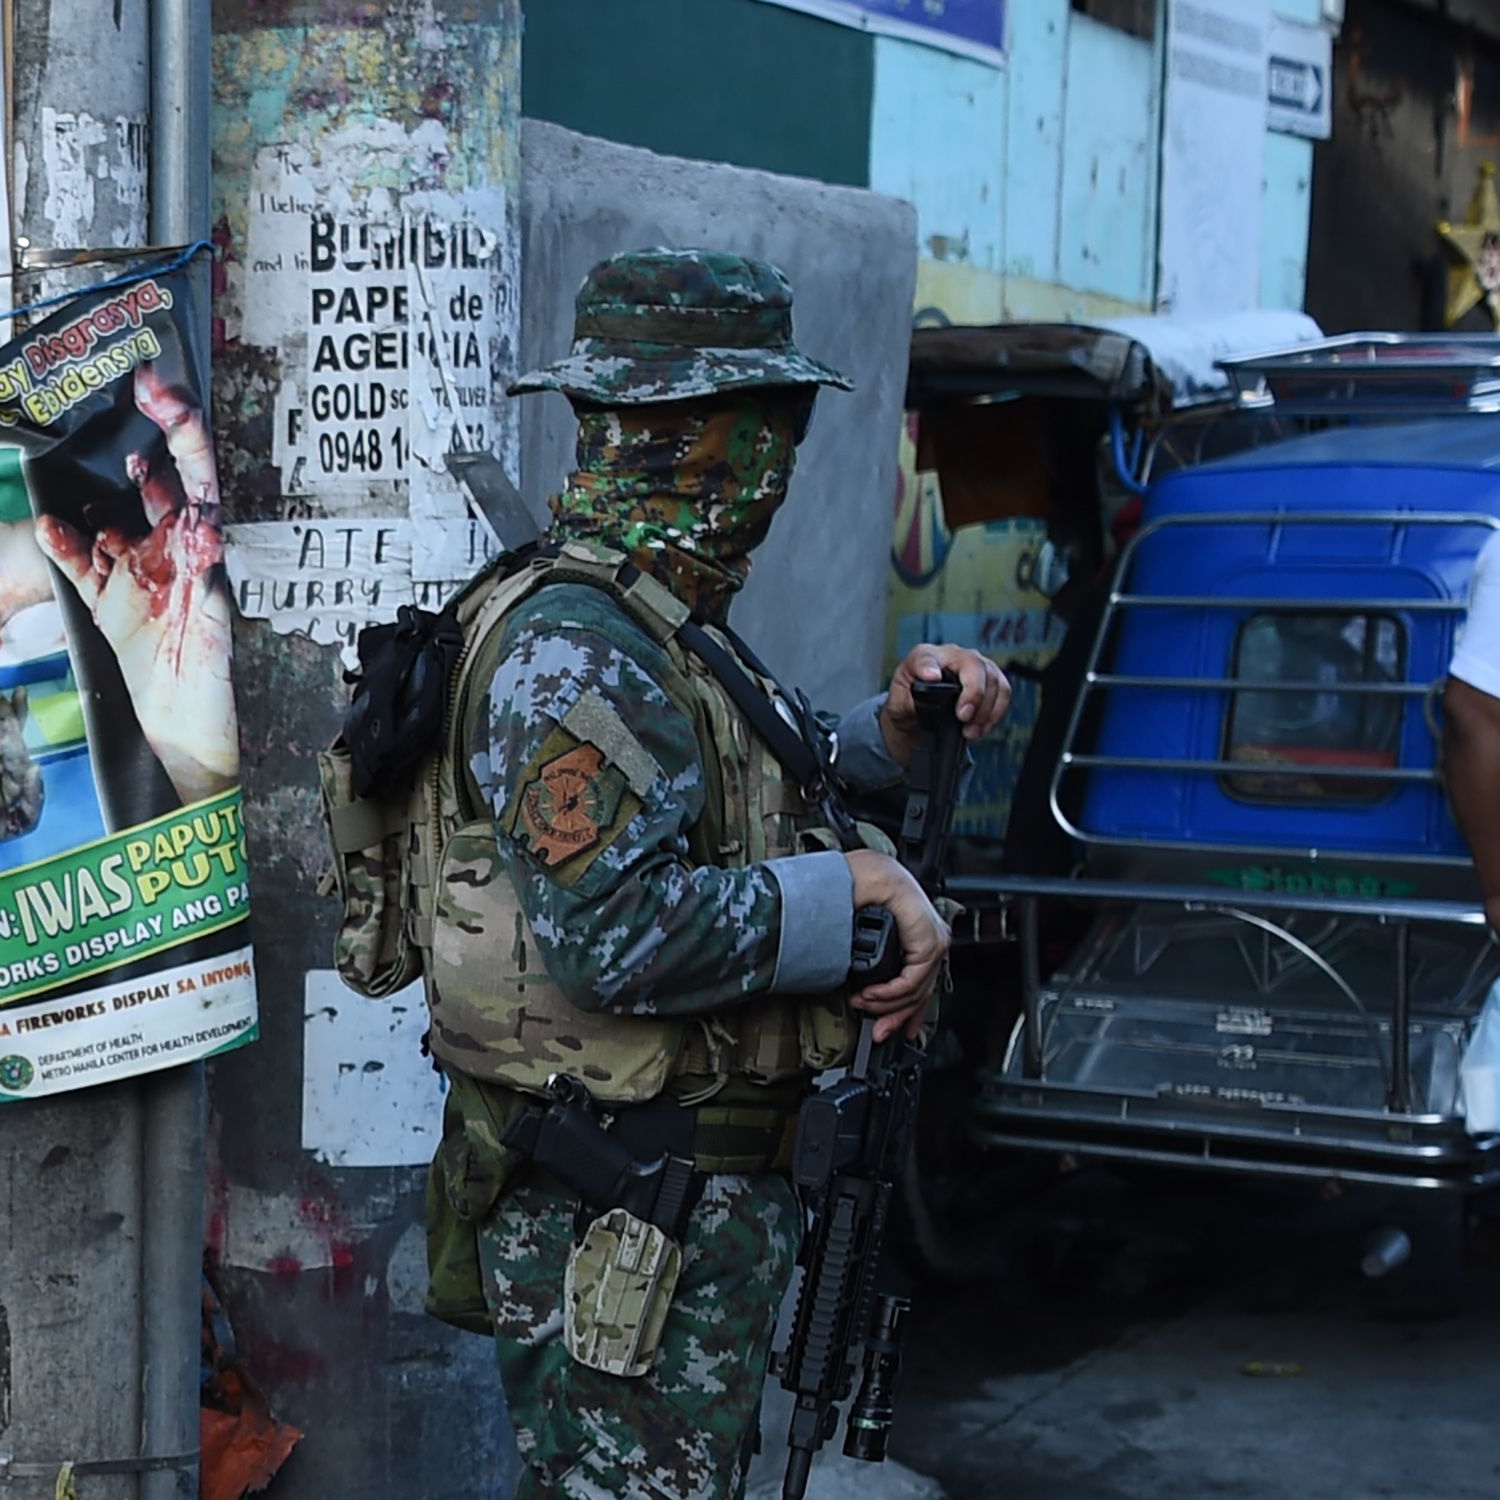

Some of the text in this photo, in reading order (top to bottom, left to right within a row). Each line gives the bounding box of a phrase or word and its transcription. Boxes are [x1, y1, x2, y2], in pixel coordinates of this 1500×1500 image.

[23, 280, 172, 378] Disgrasya,
[450, 285, 484, 322] de
[23, 328, 161, 427] Ebidensya
[311, 382, 386, 422] GOLD
[319, 428, 383, 473] 0948
[240, 579, 382, 612] HURRY
[13, 854, 134, 945] IWAS
[66, 915, 165, 968] DISPLAY
[171, 897, 224, 931] ANG
[15, 999, 107, 1034] FIREWORKS
[112, 983, 171, 1012] DISPLAY
[176, 977, 197, 994] SA
[201, 960, 252, 988] INYONG
[37, 1032, 144, 1067] DEPARTMENT OF HEALTH
[40, 1016, 253, 1081] METRO MANILA CENTER FOR HEALTH DEVELOPMENT
